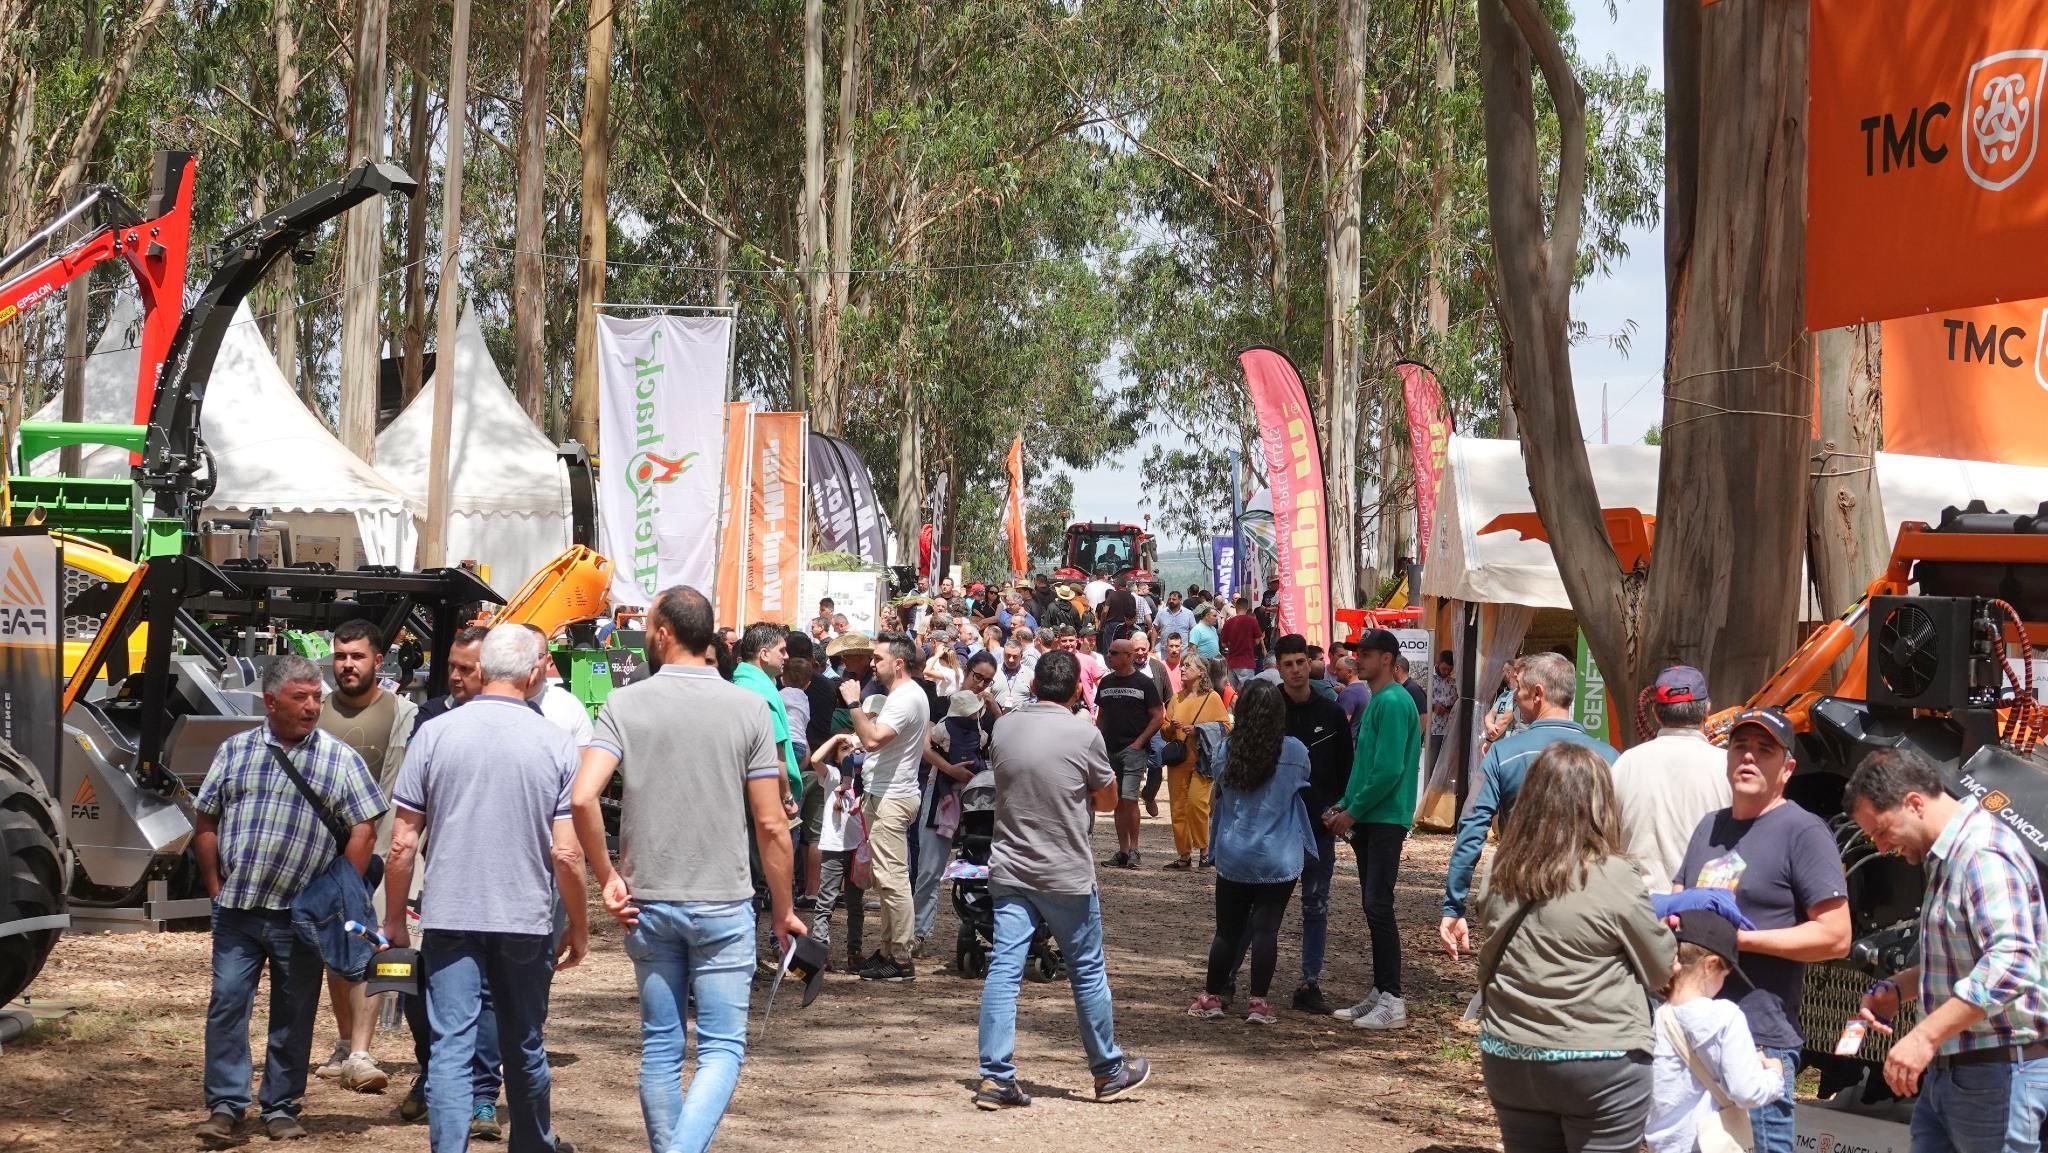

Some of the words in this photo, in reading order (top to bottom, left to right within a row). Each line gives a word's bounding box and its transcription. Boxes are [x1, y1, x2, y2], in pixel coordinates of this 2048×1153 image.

[1861, 102, 1951, 176] TMC
[17, 283, 52, 308] EPSILON
[1944, 319, 2026, 368] TMC
[1217, 547, 1234, 603] MATSU
[1960, 774, 1987, 797] TMC
[71, 805, 100, 820] FAE
[1796, 1135, 1817, 1149] TMC
